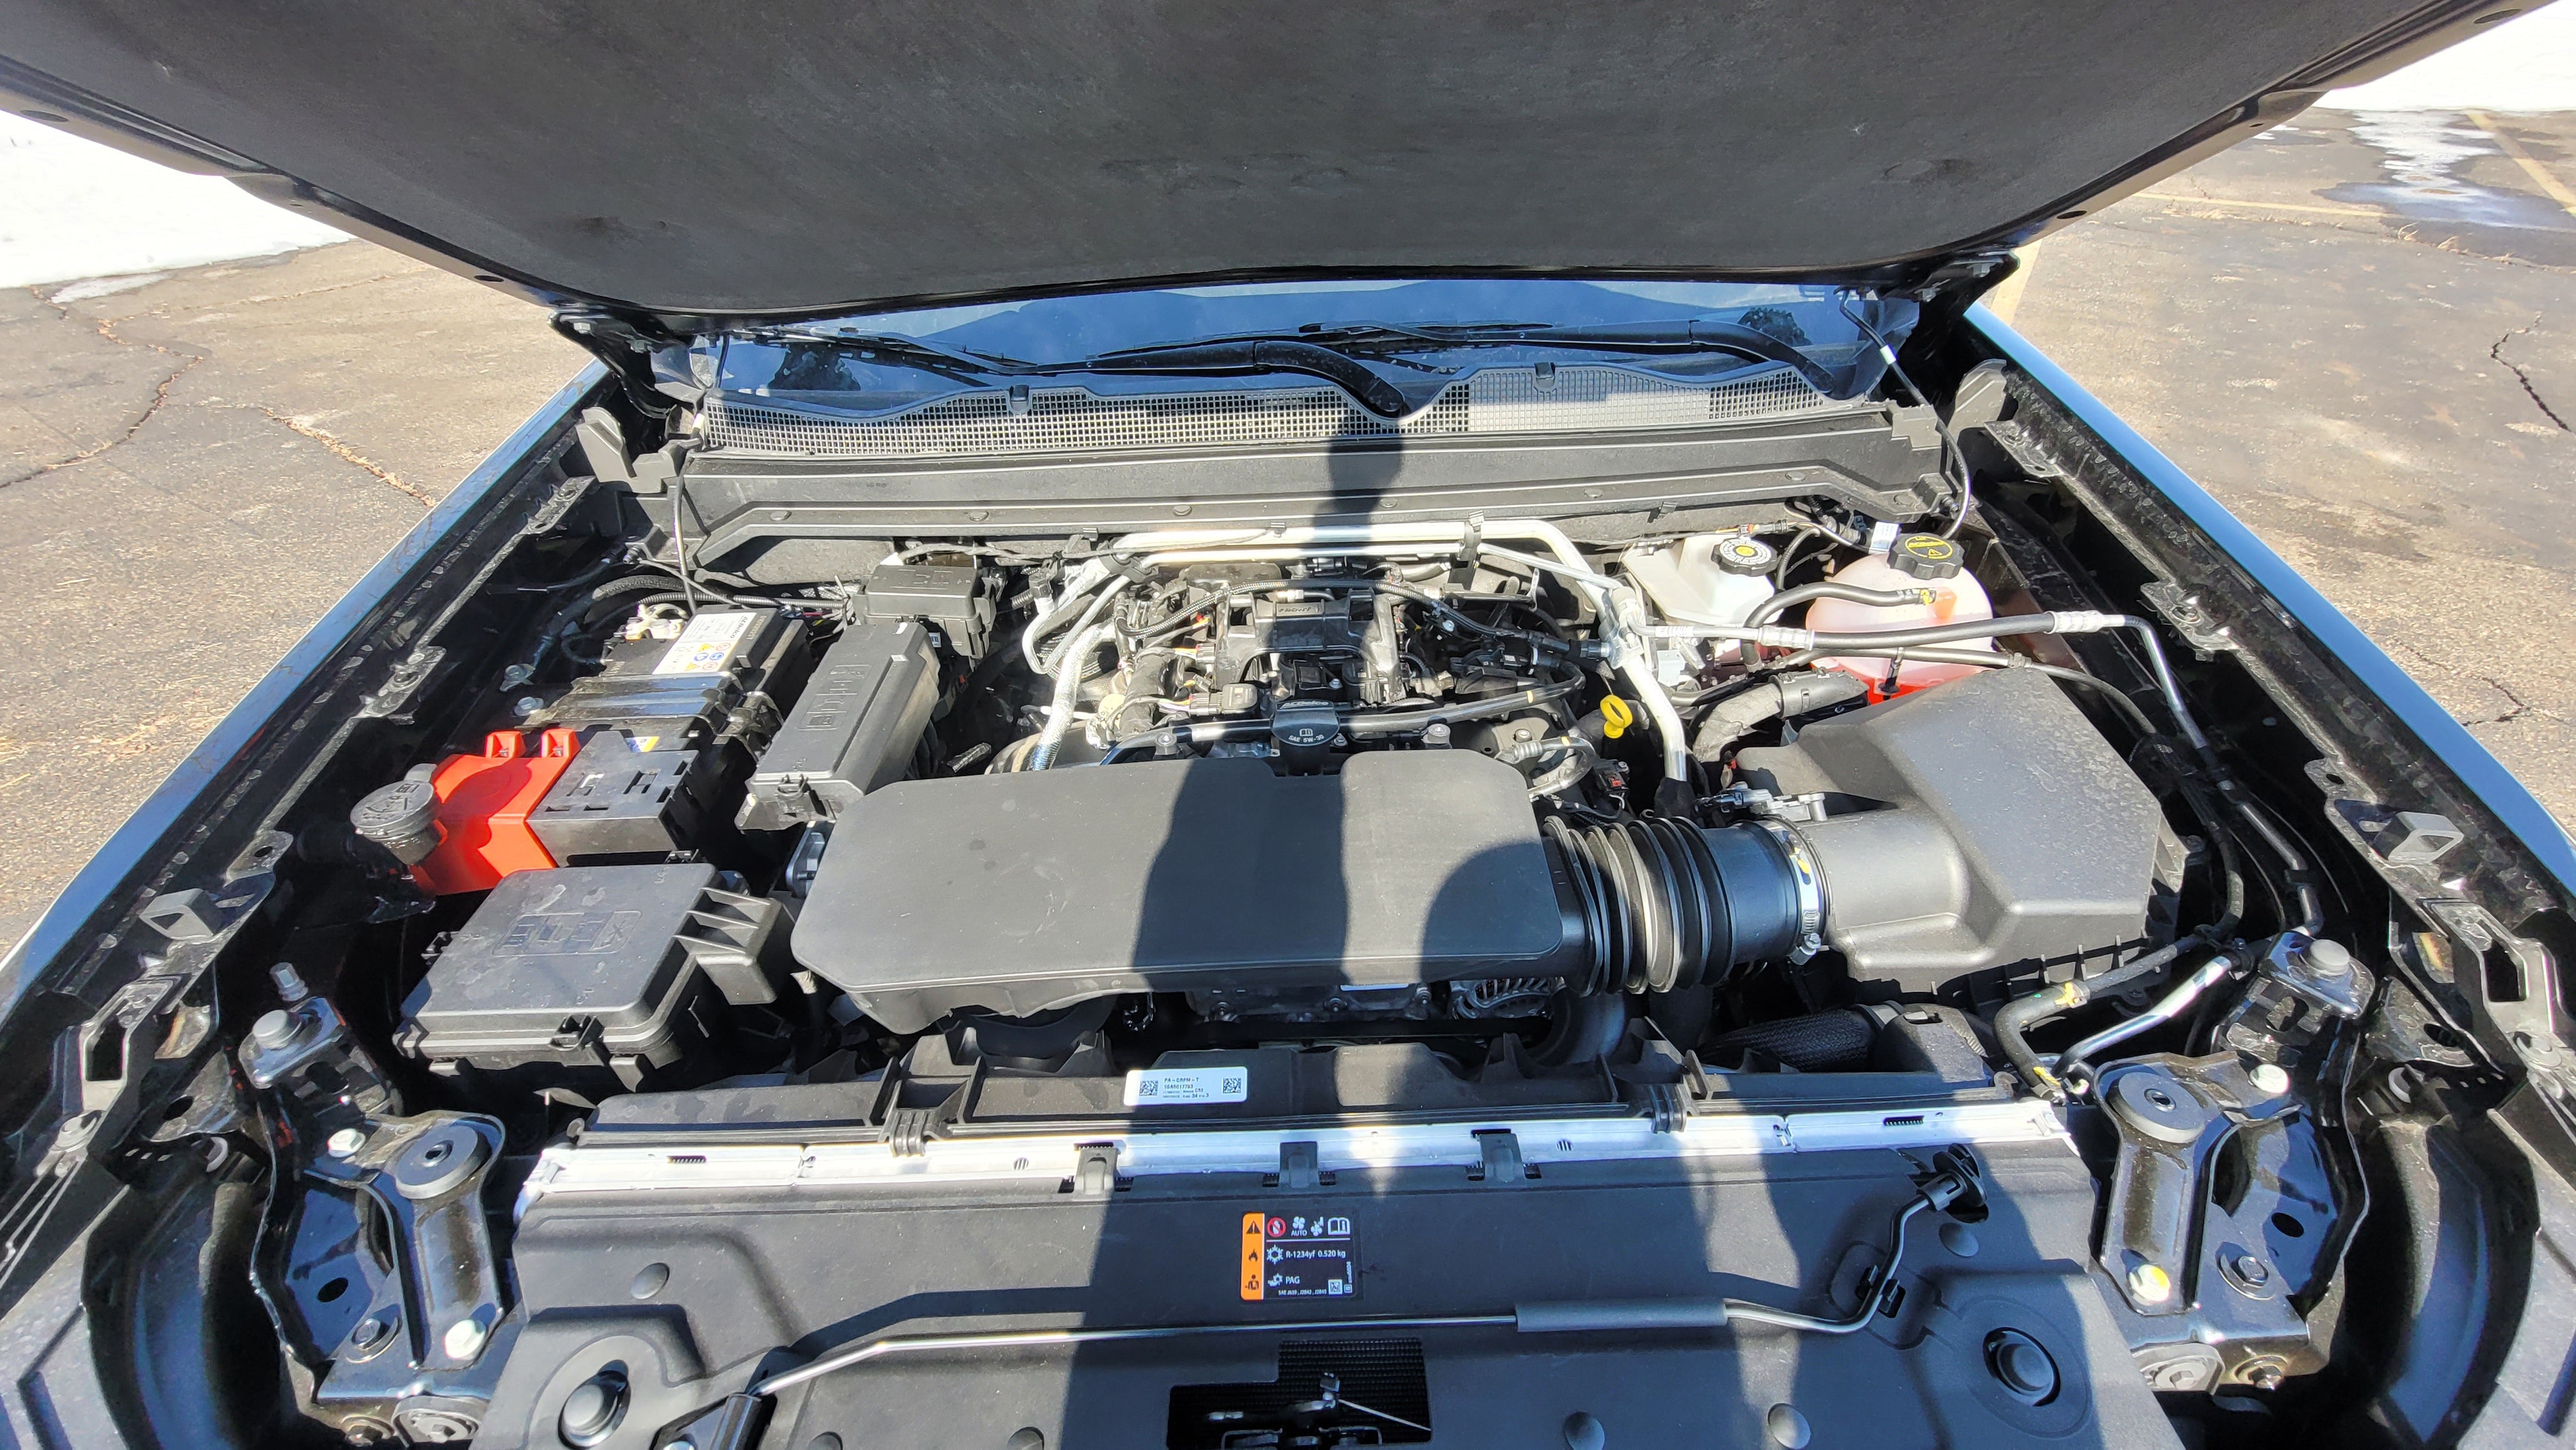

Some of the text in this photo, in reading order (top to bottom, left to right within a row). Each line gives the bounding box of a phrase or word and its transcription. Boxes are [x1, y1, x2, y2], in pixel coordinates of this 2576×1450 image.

[730, 616, 748, 639] ACDelco
[1303, 734, 1325, 742] 5W-30
[1285, 1249, 1346, 1259] R-1234yf 0.520 kg
